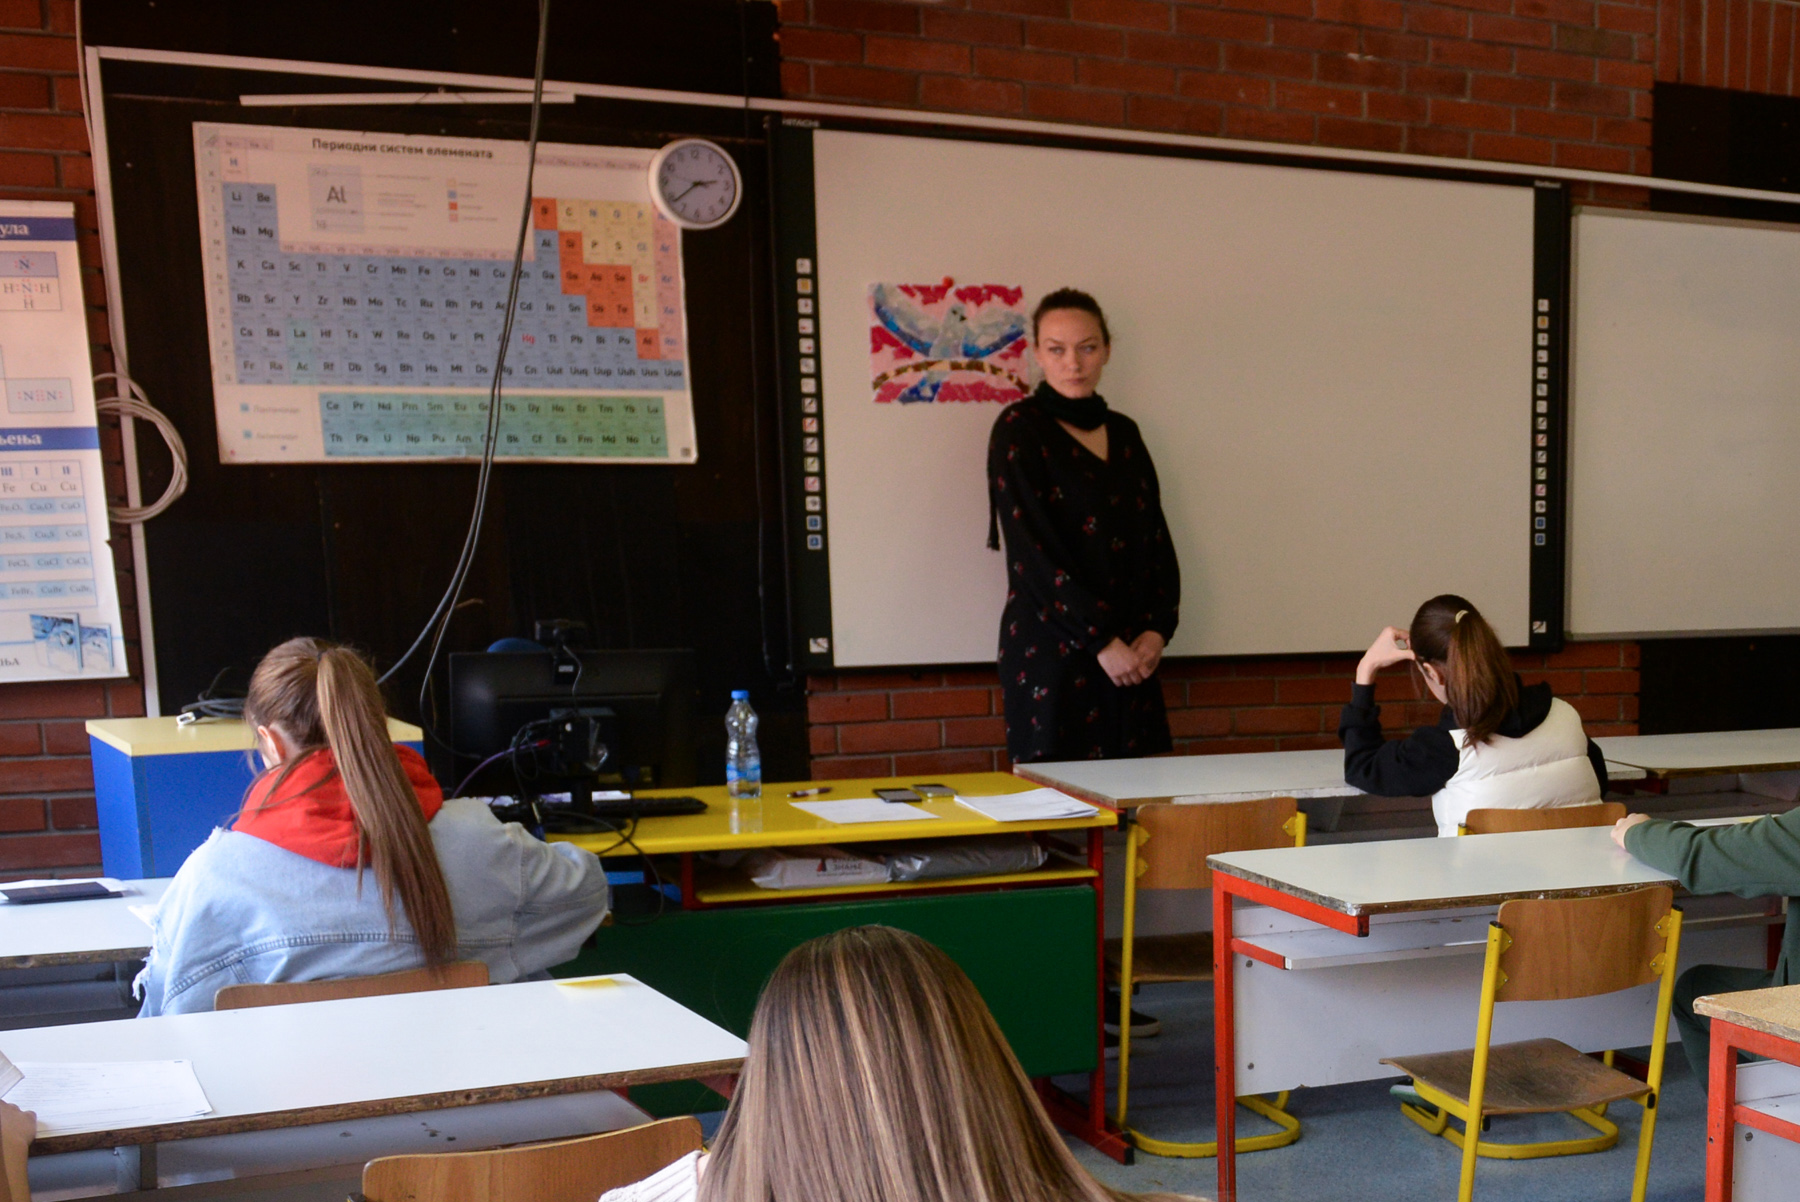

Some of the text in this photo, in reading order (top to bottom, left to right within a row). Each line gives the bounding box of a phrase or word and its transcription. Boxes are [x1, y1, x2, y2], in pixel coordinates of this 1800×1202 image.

[312, 138, 493, 159] Периодни систем елемената
[19, 259, 30, 270] N
[4, 284, 14, 293] H
[41, 283, 50, 293] H
[2, 480, 76, 493] Fe Cu Cu
